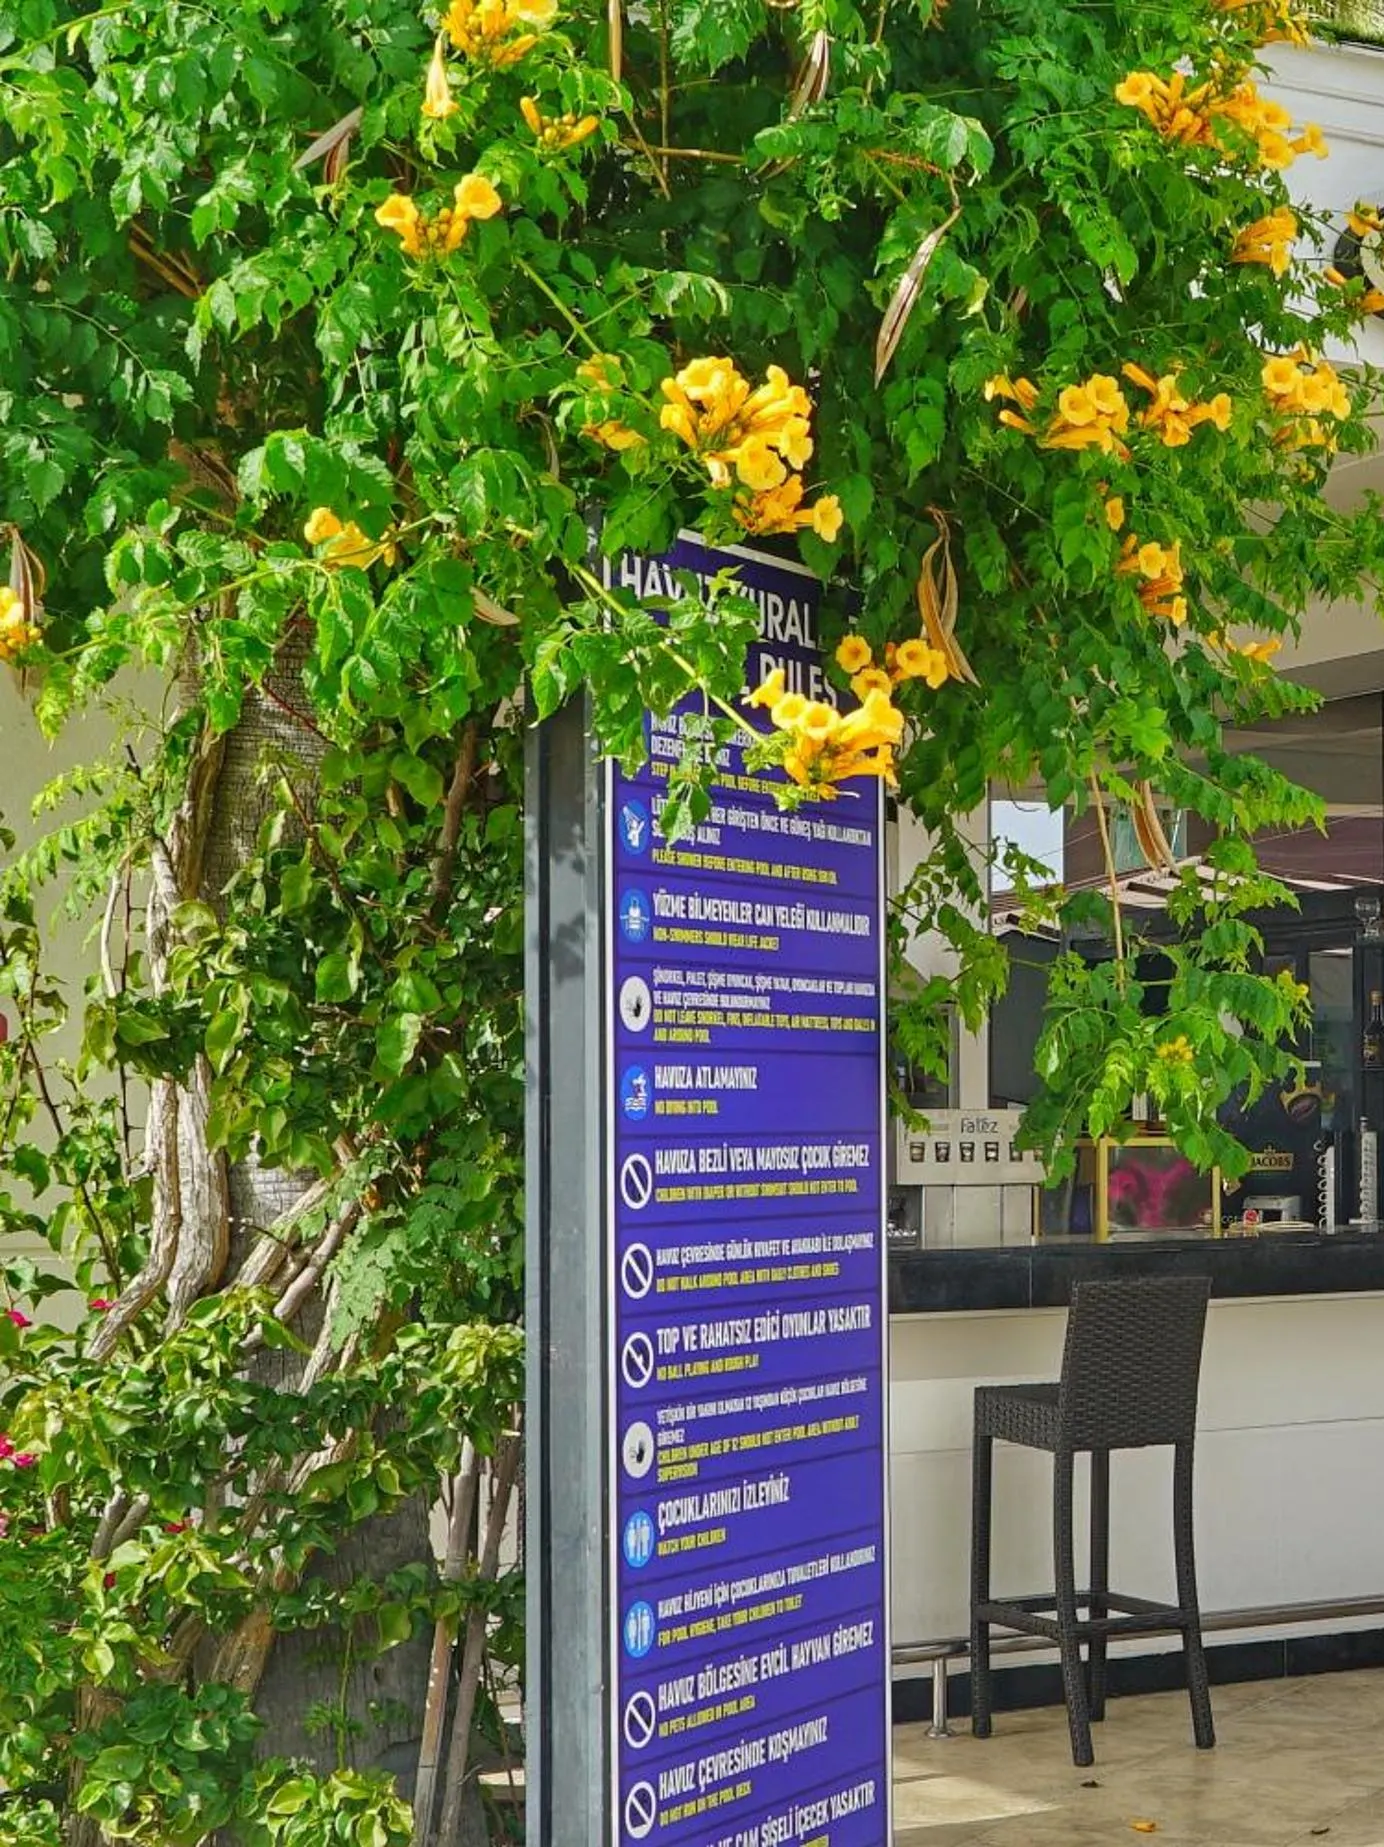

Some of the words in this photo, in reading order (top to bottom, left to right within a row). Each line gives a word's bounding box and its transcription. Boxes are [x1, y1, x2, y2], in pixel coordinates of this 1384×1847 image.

[653, 888, 687, 918] YÜZME
[688, 891, 753, 924] BİLMEYENLER
[655, 1066, 693, 1089] HAVUZA
[695, 1066, 757, 1089] ATLAMAYINIZ
[655, 1148, 697, 1174] HAVUZA
[698, 1142, 728, 1173] BEZLİ
[729, 1147, 755, 1172] VEYA
[801, 1145, 831, 1175] ÇOCUK
[656, 1327, 679, 1354] TOP
[682, 1324, 698, 1352] VE
[700, 1318, 752, 1350] RAHATSIZ
[754, 1309, 780, 1343] EDİCİ
[782, 1309, 826, 1339] OYUNLAR
[827, 1304, 871, 1333] YASAKTIR
[658, 1487, 740, 1535] ÇOCUKLARINIZI
[743, 1472, 790, 1511] İZLEYİNİZ
[658, 1674, 695, 1712] HAVUZ
[697, 1653, 759, 1701] BÖLGESİNE
[760, 1642, 790, 1681] EVCİL
[791, 1633, 832, 1671] HAYVAN
[832, 1621, 874, 1656] GİREMEZ
[659, 1762, 696, 1801] HAVUZ
[698, 1739, 766, 1793] ÇEVRESİNDE
[768, 1716, 828, 1764] KOŞMAYINIZ
[795, 1798, 829, 1840] İÇECEK
[830, 1780, 875, 1820] YASAKTIR
